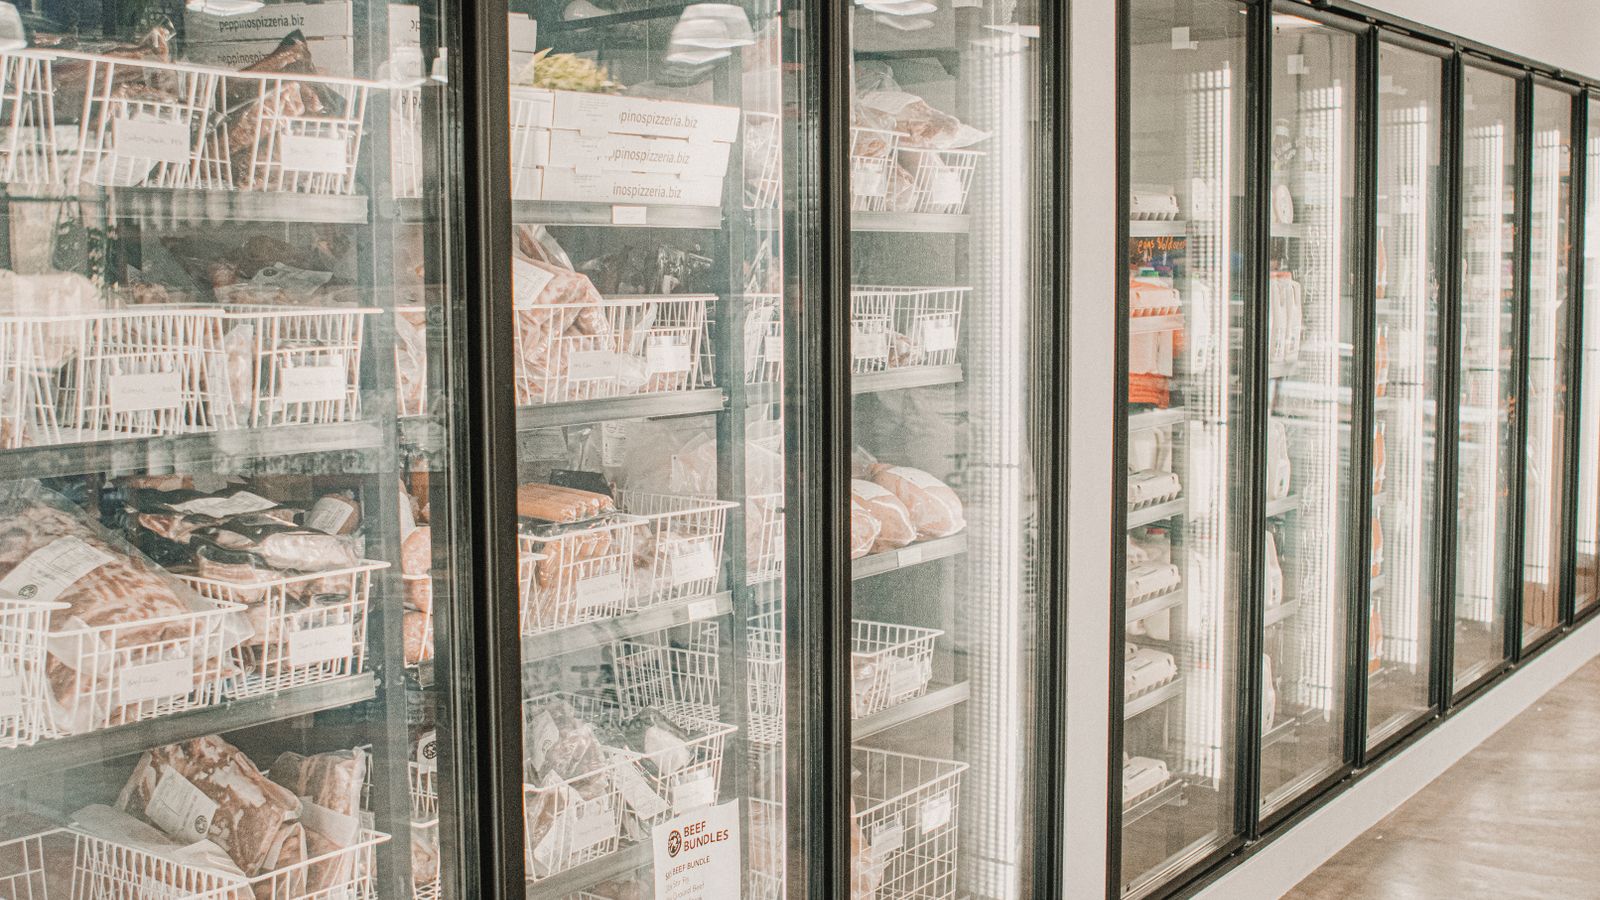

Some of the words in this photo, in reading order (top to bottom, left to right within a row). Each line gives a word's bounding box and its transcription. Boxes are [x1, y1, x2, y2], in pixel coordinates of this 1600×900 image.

[218, 14, 305, 32] peppinospizzeria.biz
[612, 183, 682, 199] inospizzeria.biz
[684, 821, 706, 837] BEEF
[684, 829, 729, 851] BUNDLES
[672, 864, 686, 876] BEEF
[687, 856, 710, 869] BUNDLE
